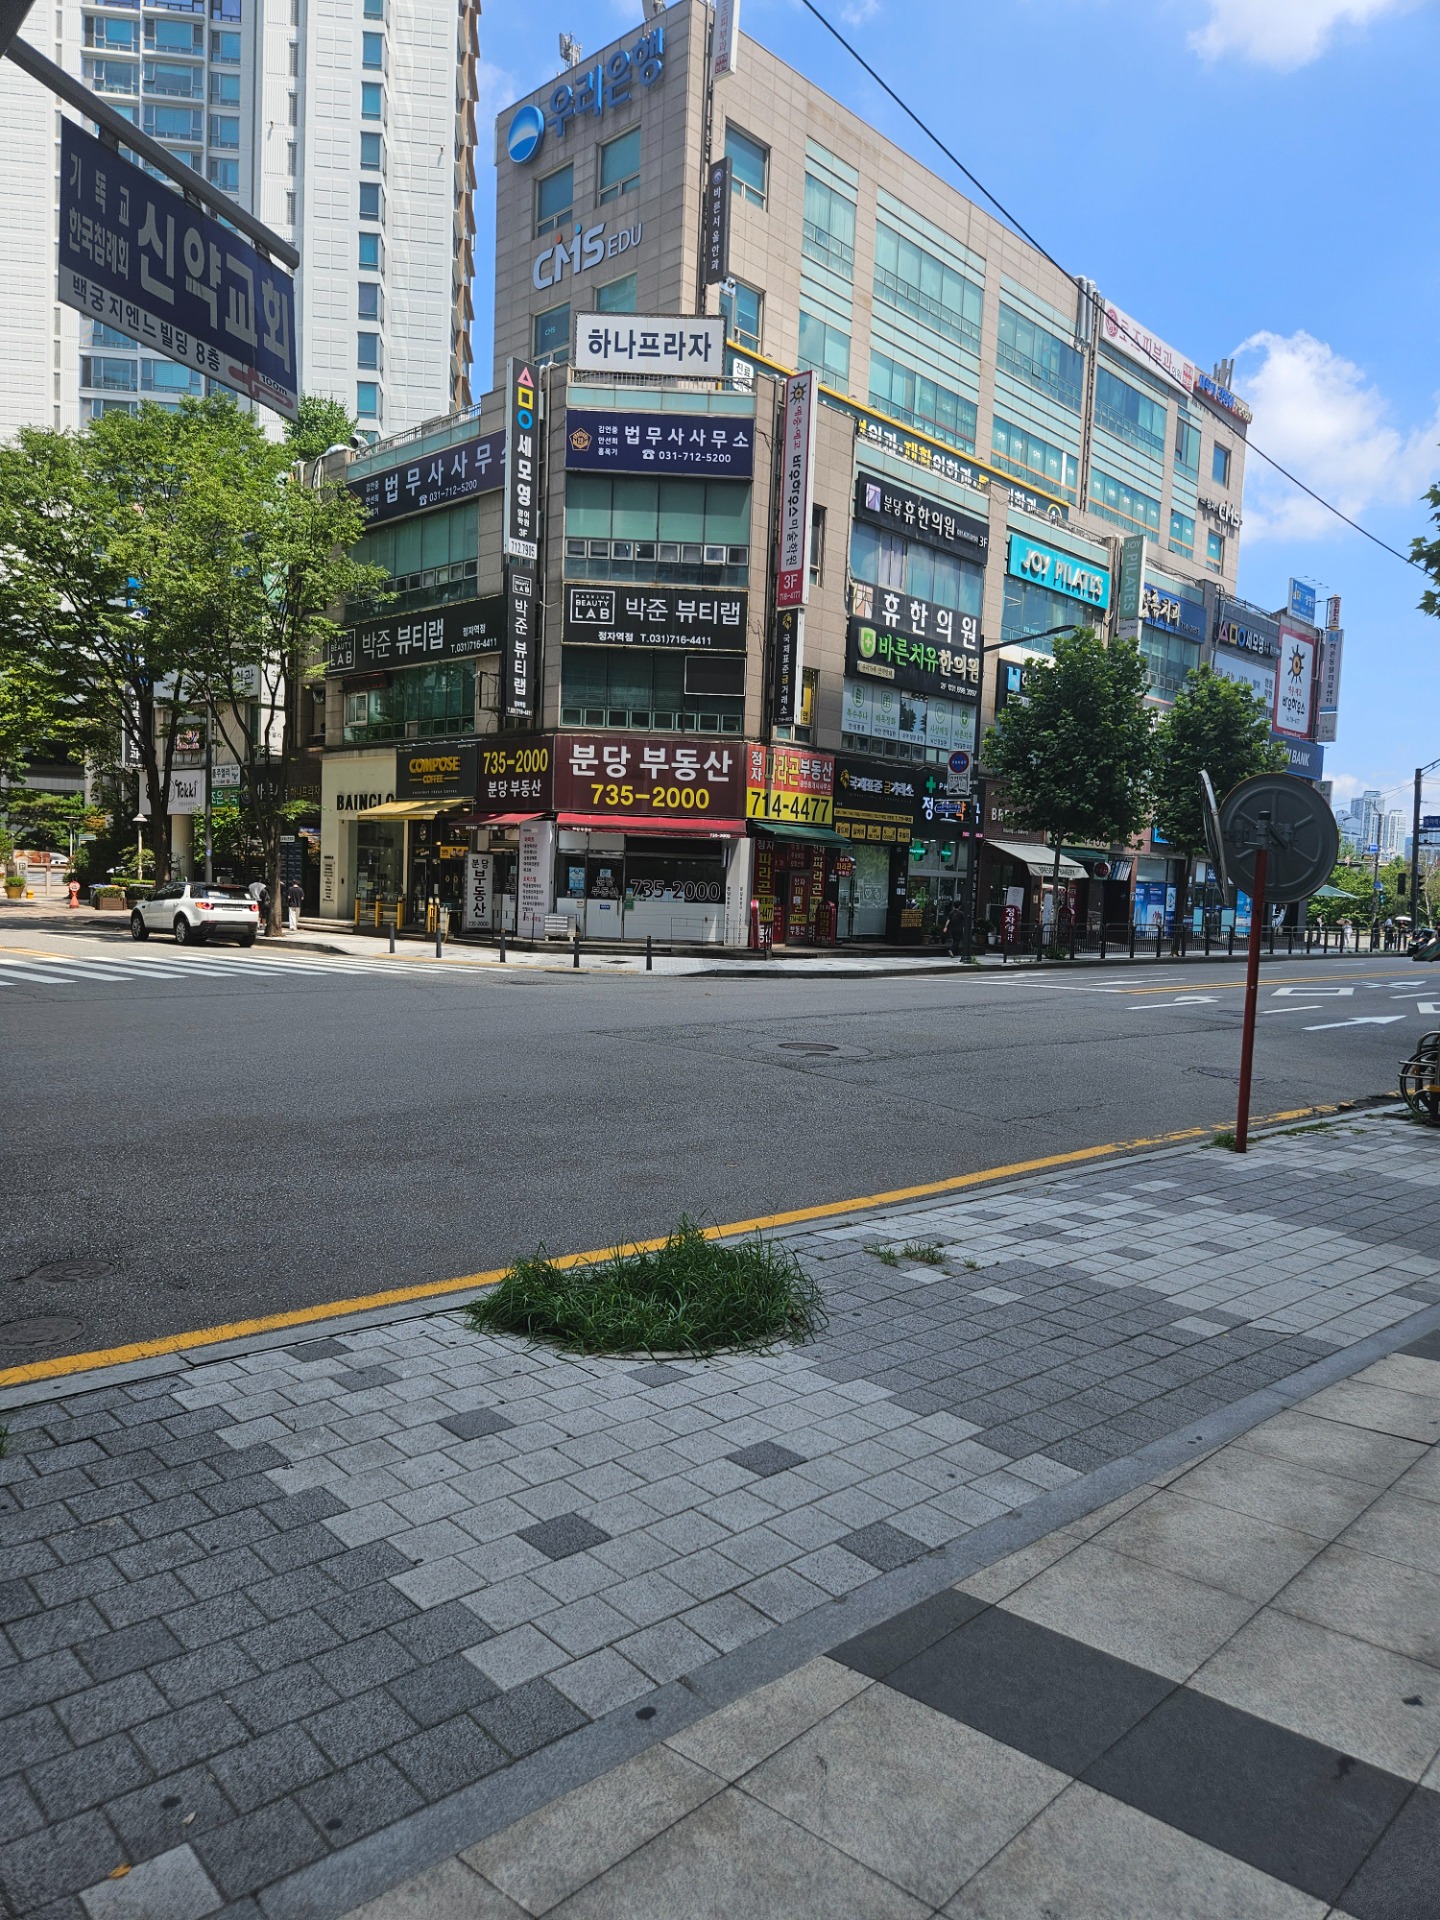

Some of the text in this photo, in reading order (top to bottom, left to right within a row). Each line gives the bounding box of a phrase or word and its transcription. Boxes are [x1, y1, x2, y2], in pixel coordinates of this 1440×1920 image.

[547, 27, 664, 138] 우리은행
[70, 153, 130, 228] 기독교
[69, 207, 129, 281] 한국침례회
[532, 222, 643, 290] CMS EDU
[138, 201, 291, 374] 신약교회
[196, 336, 221, 373] 8층
[588, 328, 712, 362] 하나프라자
[624, 425, 749, 448] 법무사사무소
[517, 434, 532, 507] 세모영
[658, 451, 732, 463] 031-712-5200
[429, 479, 478, 502] 031-712-5200
[518, 528, 528, 537] 3F
[883, 494, 903, 517] 분당
[903, 500, 955, 540] 휴한의원
[978, 535, 988, 548] 3F
[783, 573, 798, 590] 3F
[1022, 547, 1104, 598] JOY PILATES
[1123, 553, 1139, 612] PILATES
[575, 593, 610, 601] PARKJUN
[575, 599, 610, 608] BEAUTY
[625, 597, 741, 626] 박준 뷰티랩
[514, 598, 528, 636] 박준
[575, 608, 611, 620] LAB
[882, 592, 977, 650] 휴한의원
[362, 617, 444, 660] 박준 뷰티랩
[598, 631, 635, 643] 정자역점
[639, 632, 712, 646] T.031)716-4411
[330, 653, 353, 668] LAB
[513, 640, 528, 696] 뷰티랩
[877, 633, 980, 685] 바른치유한의원
[409, 757, 461, 774] COMPOSE
[483, 748, 549, 775] 735-2000
[568, 744, 734, 783] 분당 부동산
[750, 751, 763, 782] 정자
[764, 753, 833, 786] 파라곤 부동산
[1291, 750, 1310, 767] BANK
[422, 775, 445, 784] COFFEE
[487, 779, 542, 799] 분당 부동산
[590, 783, 711, 809] 735-2000
[750, 791, 831, 822] 714-4477
[472, 858, 490, 870] 분당
[757, 852, 772, 894] 파라곤
[812, 856, 823, 895] 파라곤
[473, 869, 487, 918] 부동산
[630, 878, 721, 901] 735-2000
